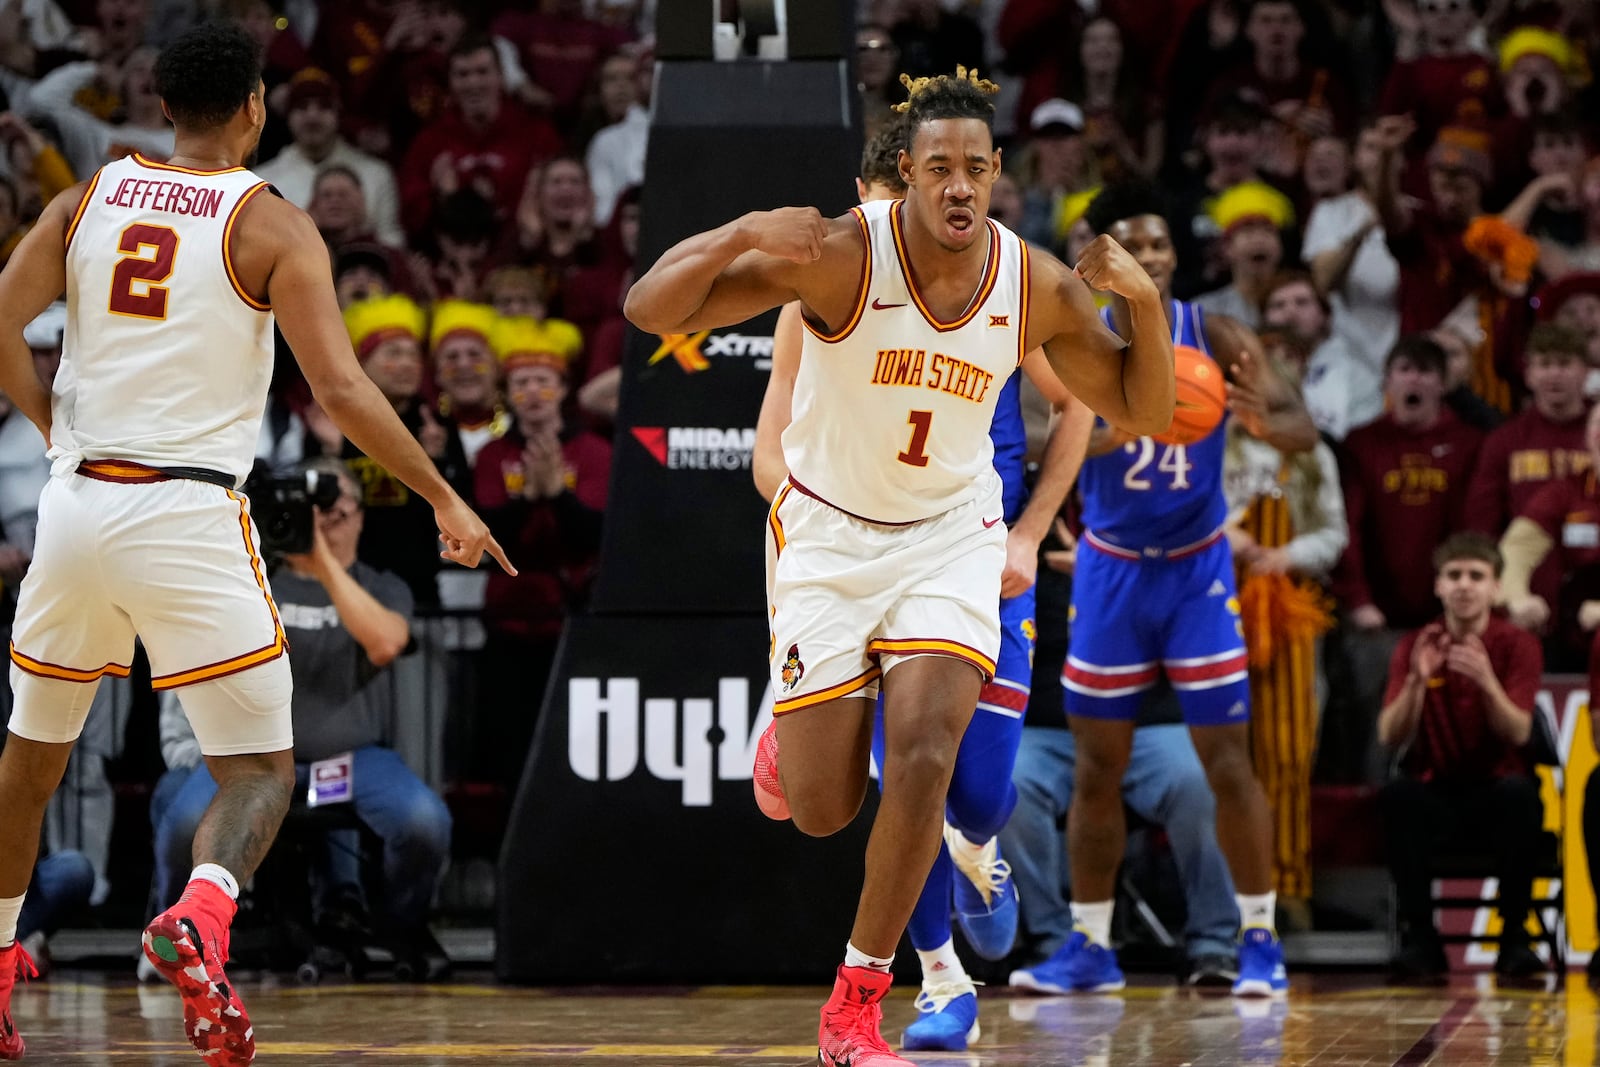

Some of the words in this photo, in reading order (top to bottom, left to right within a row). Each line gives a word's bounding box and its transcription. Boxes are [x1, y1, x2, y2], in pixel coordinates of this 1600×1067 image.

[105, 178, 224, 218] JEFFERSON
[108, 221, 181, 321] 2
[871, 350, 926, 386] IOWA
[926, 353, 994, 404] STATE
[896, 409, 933, 467] 1
[1124, 436, 1192, 490] 24
